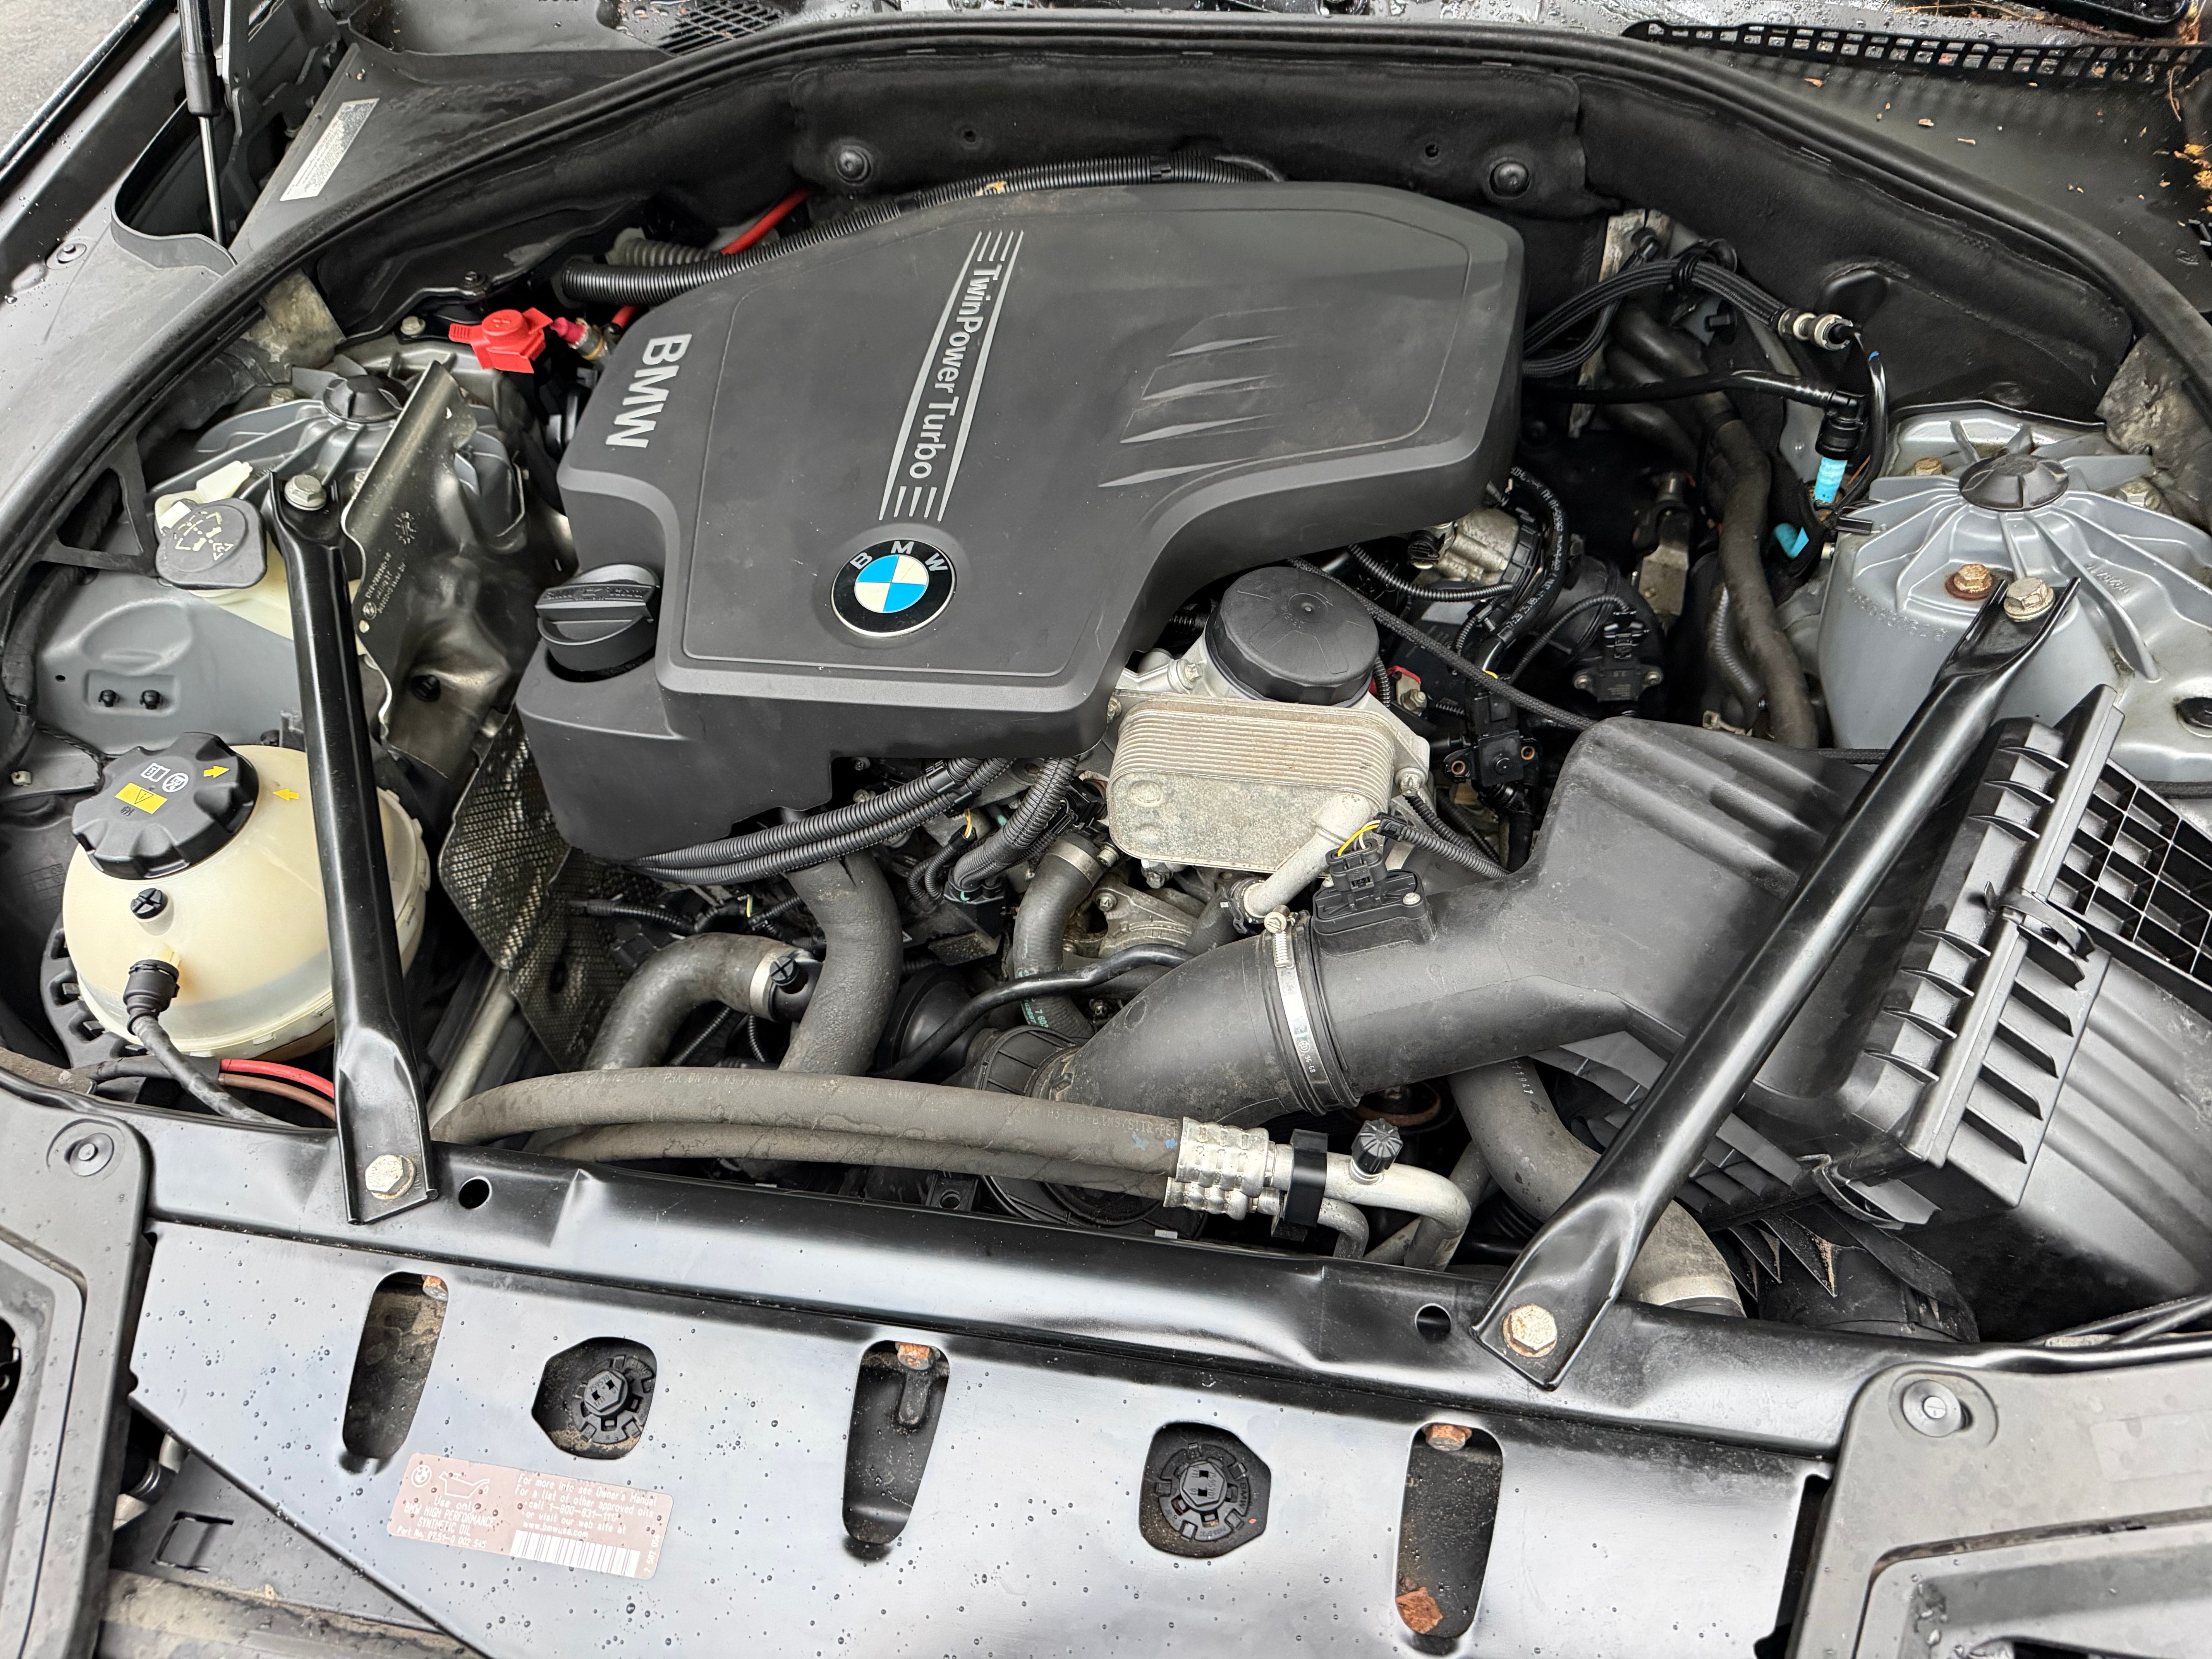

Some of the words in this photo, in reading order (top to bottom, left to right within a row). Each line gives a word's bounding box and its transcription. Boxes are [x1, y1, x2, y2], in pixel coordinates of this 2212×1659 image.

[934, 264, 1002, 393] TwinPower
[606, 334, 692, 448] BMW
[909, 396, 960, 479] Turbo
[850, 541, 948, 572] BMW
[434, 1495, 451, 1506] Use
[515, 1485, 529, 1496] For
[541, 1489, 556, 1501] list
[560, 1492, 570, 1503] of
[573, 1494, 595, 1508] other
[598, 1500, 635, 1514] approved
[637, 1505, 654, 1518] oils
[518, 1473, 532, 1485] For
[536, 1479, 555, 1489] more
[558, 1481, 574, 1492] info
[578, 1486, 592, 1496] see
[596, 1486, 626, 1501] Owner's
[629, 1492, 658, 1507] Manual
[1239, 1482, 1248, 1510] BMW
[404, 1502, 422, 1515] BMW
[425, 1505, 442, 1518] HIGH
[444, 1508, 495, 1528] PERFORMANCE
[526, 1511, 535, 1519] or
[538, 1511, 558, 1523] visit
[561, 1516, 575, 1525] our
[578, 1517, 593, 1528] web
[597, 1522, 613, 1532] site
[617, 1524, 626, 1535] at
[528, 1498, 544, 1510] call
[549, 1501, 619, 1522] 1-800-831-1117
[397, 1525, 412, 1536] Part
[414, 1529, 424, 1538] No.
[457, 1536, 470, 1547] 002
[473, 1539, 488, 1549] 545
[417, 1516, 457, 1534] SYNTHETIC
[459, 1524, 471, 1537] OIL
[523, 1521, 589, 1539] www.bmwusa.com
[646, 1550, 657, 1565] 502
